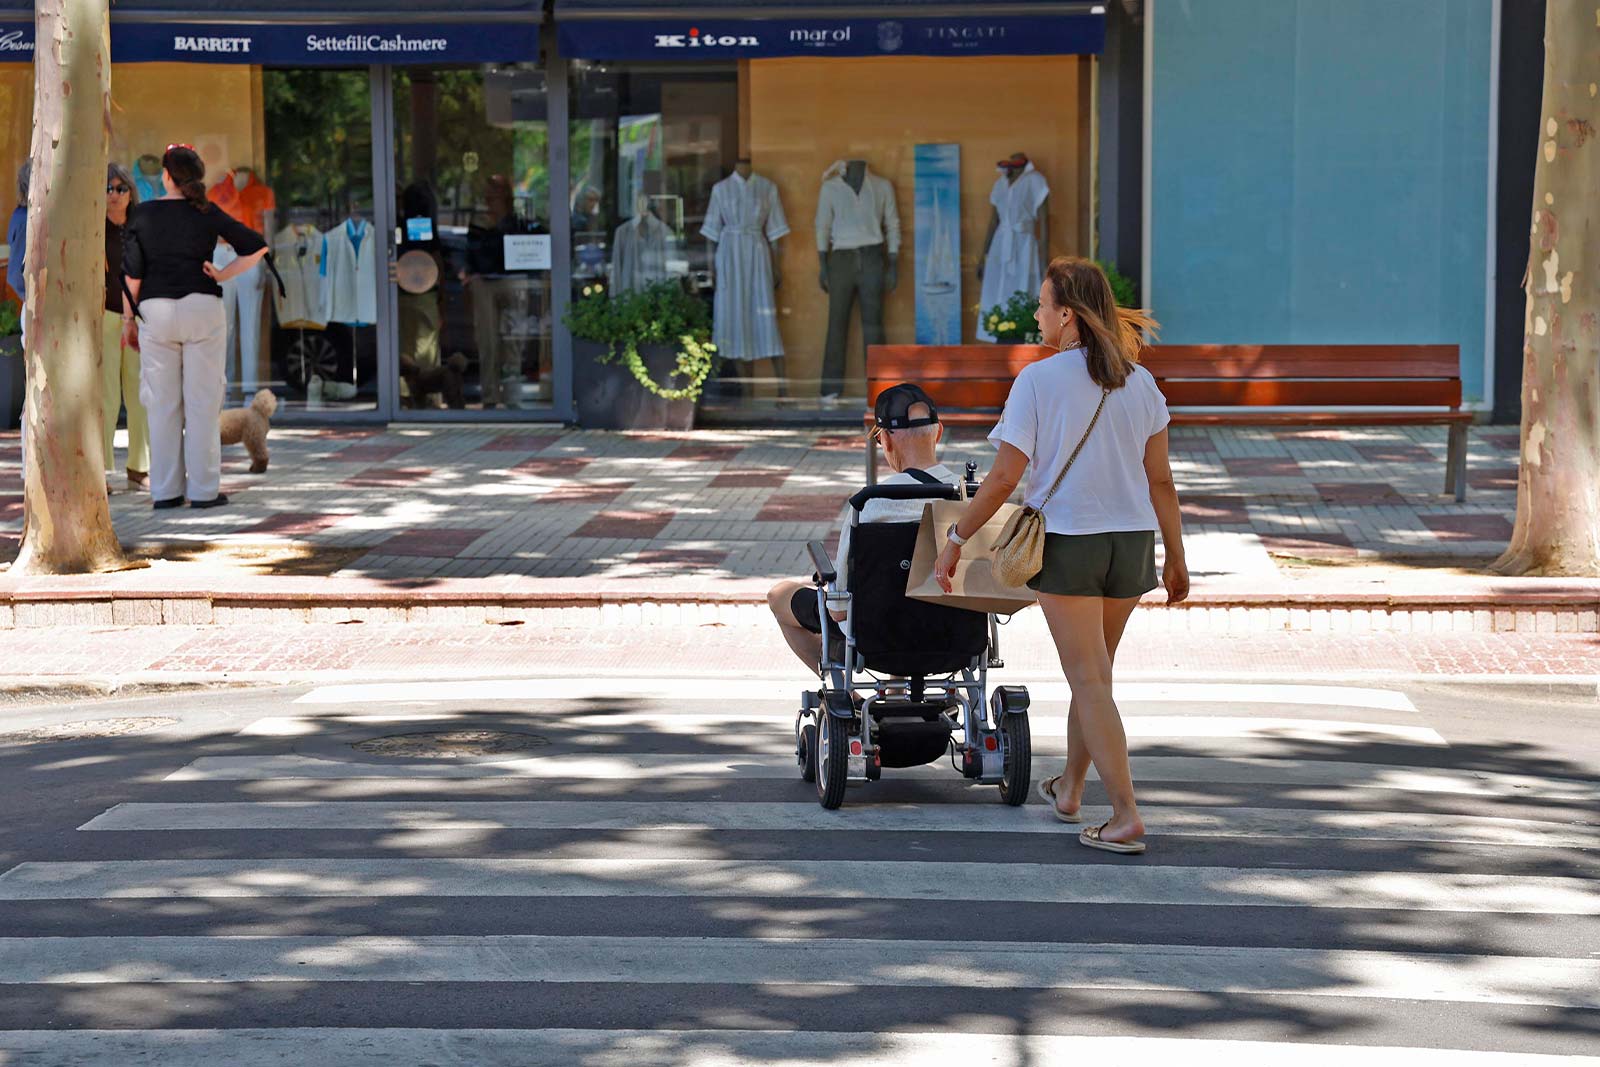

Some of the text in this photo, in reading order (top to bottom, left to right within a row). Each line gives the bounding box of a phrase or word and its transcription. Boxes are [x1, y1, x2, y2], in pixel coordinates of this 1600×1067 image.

[174, 36, 251, 52] BARRETT
[306, 34, 448, 51] SettefiliCashmere
[654, 27, 760, 47] Kiton
